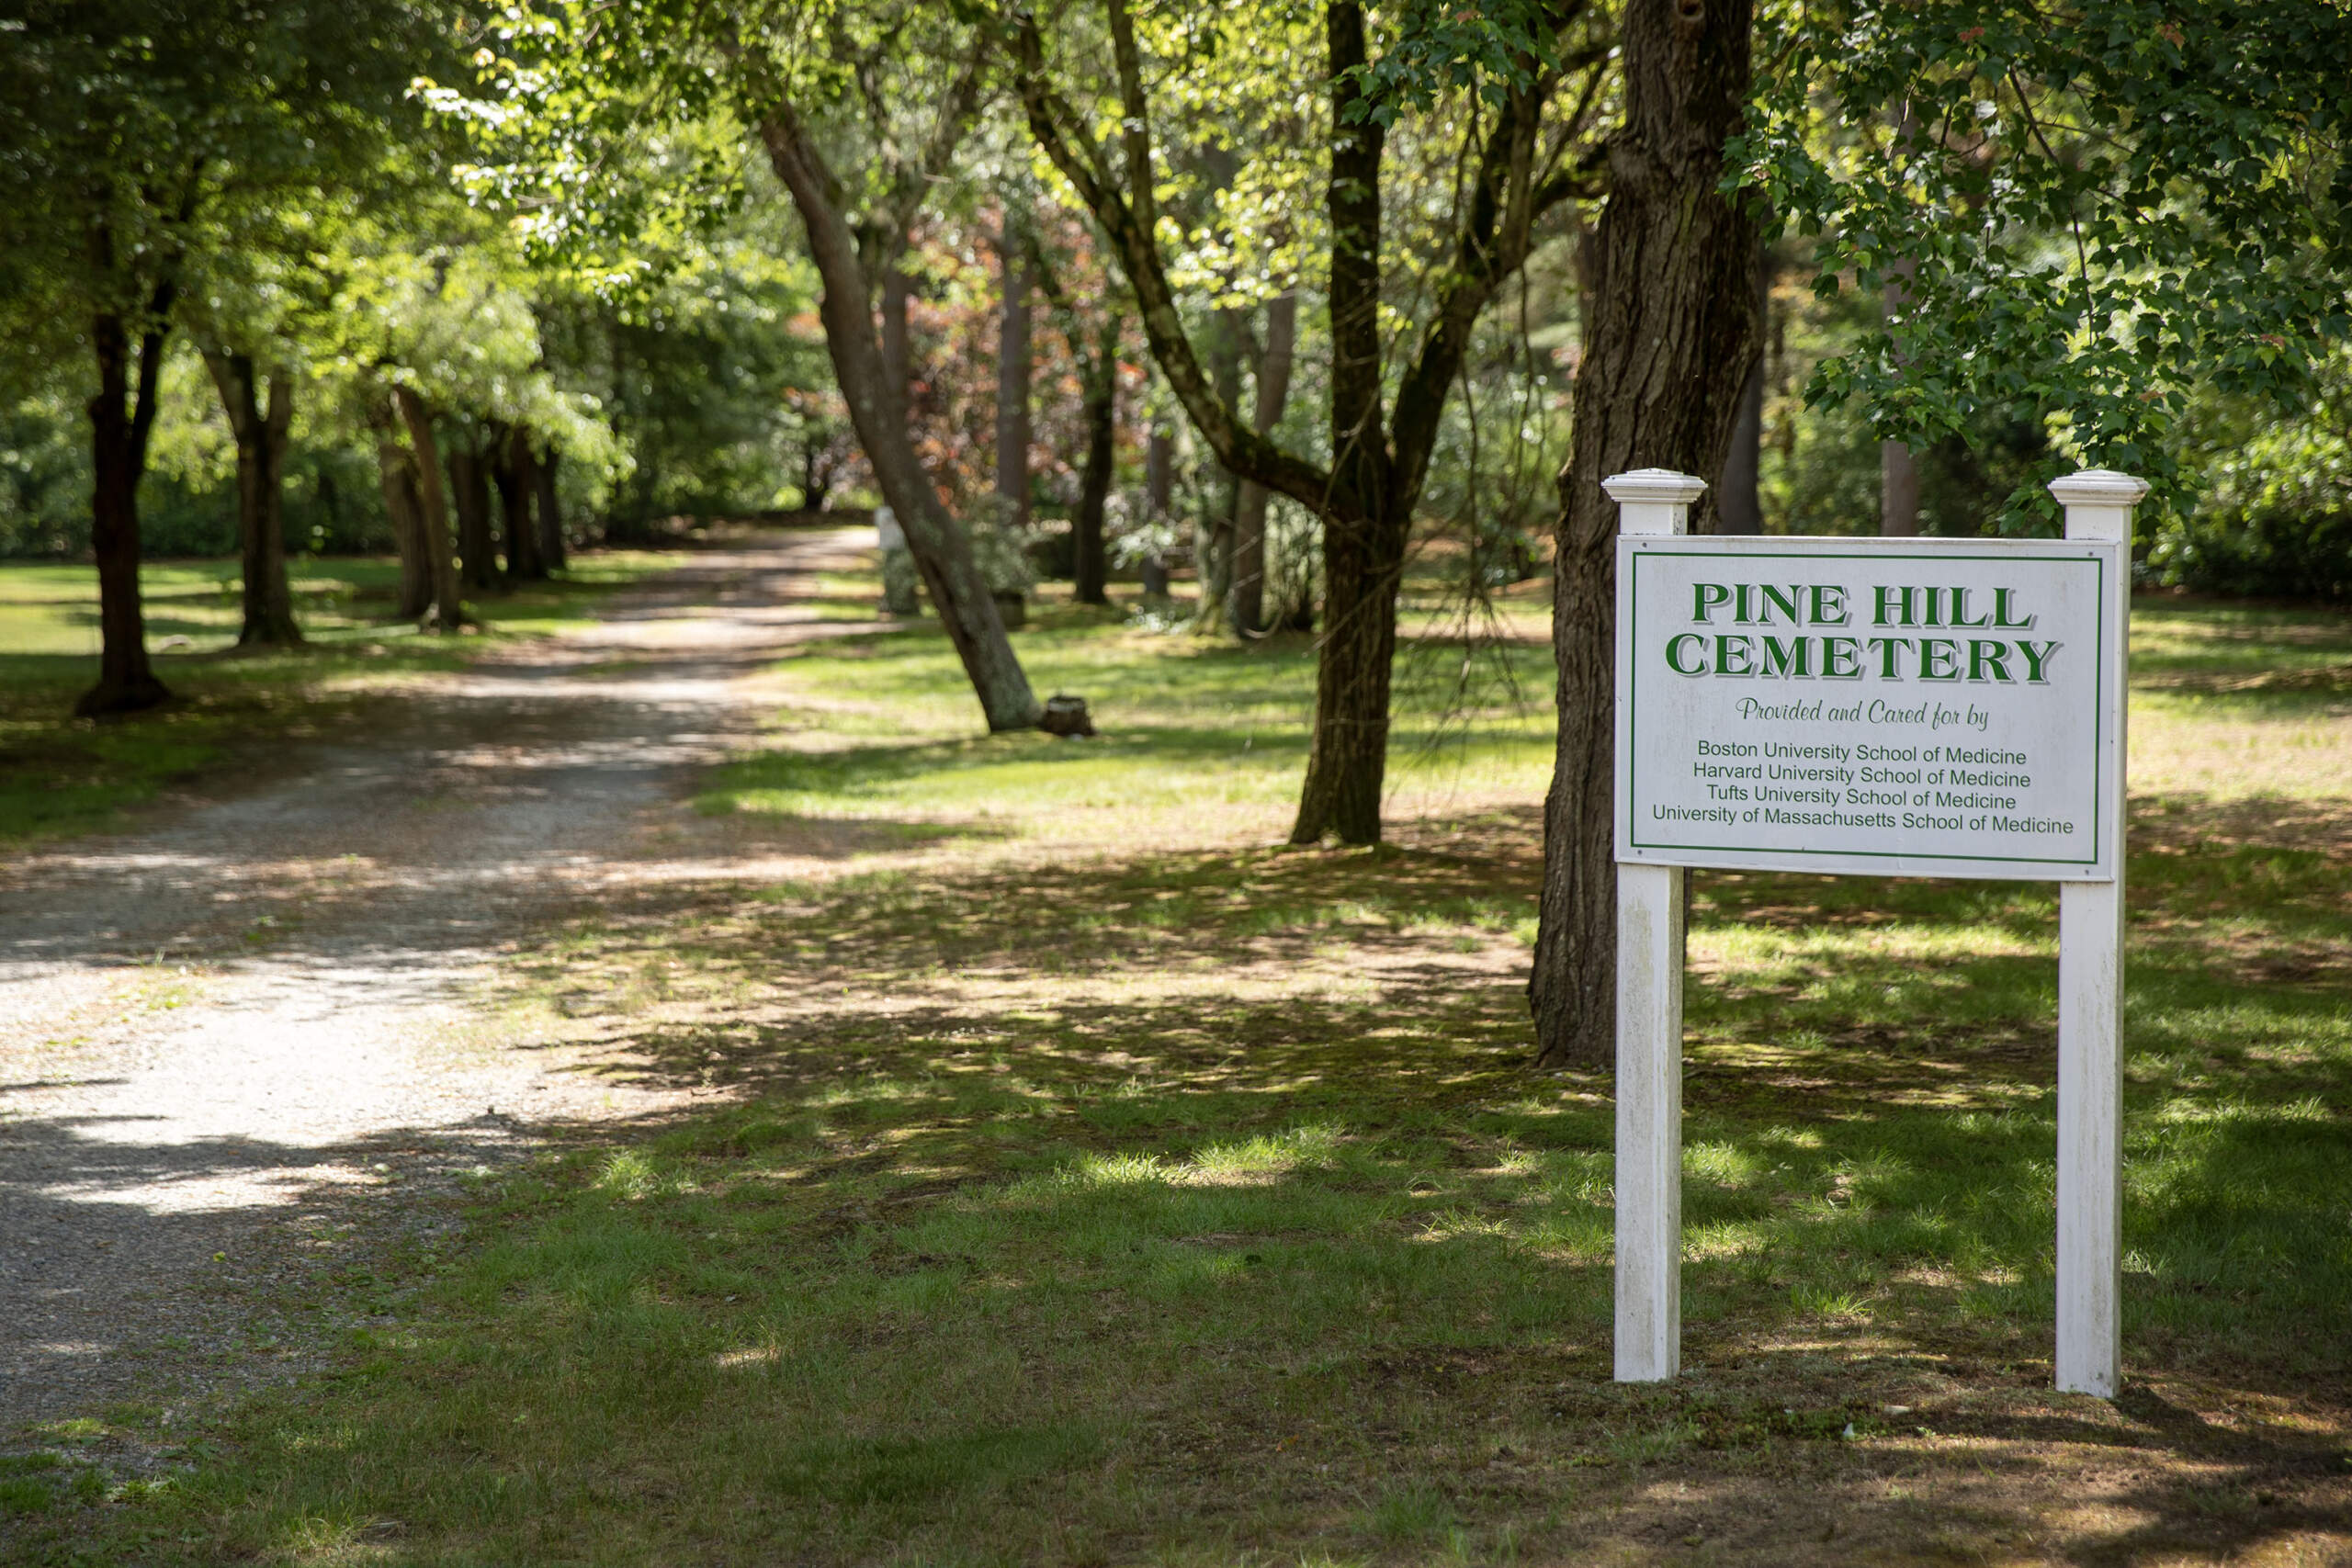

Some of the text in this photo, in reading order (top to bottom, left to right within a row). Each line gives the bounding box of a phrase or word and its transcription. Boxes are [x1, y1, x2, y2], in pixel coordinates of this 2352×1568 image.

[1690, 582, 2032, 628] PINE HILL
[1665, 632, 2056, 684] CEMETERY
[1735, 696, 1988, 732] Provided and Cared for by
[1698, 739, 2027, 765] Boston University School of Medicine
[1693, 761, 2030, 788] Harvard University School of Medicine
[1705, 784, 2017, 809] Tufts University School of Medicine
[1653, 804, 2074, 834] University of Massachusetts School of Medicine
